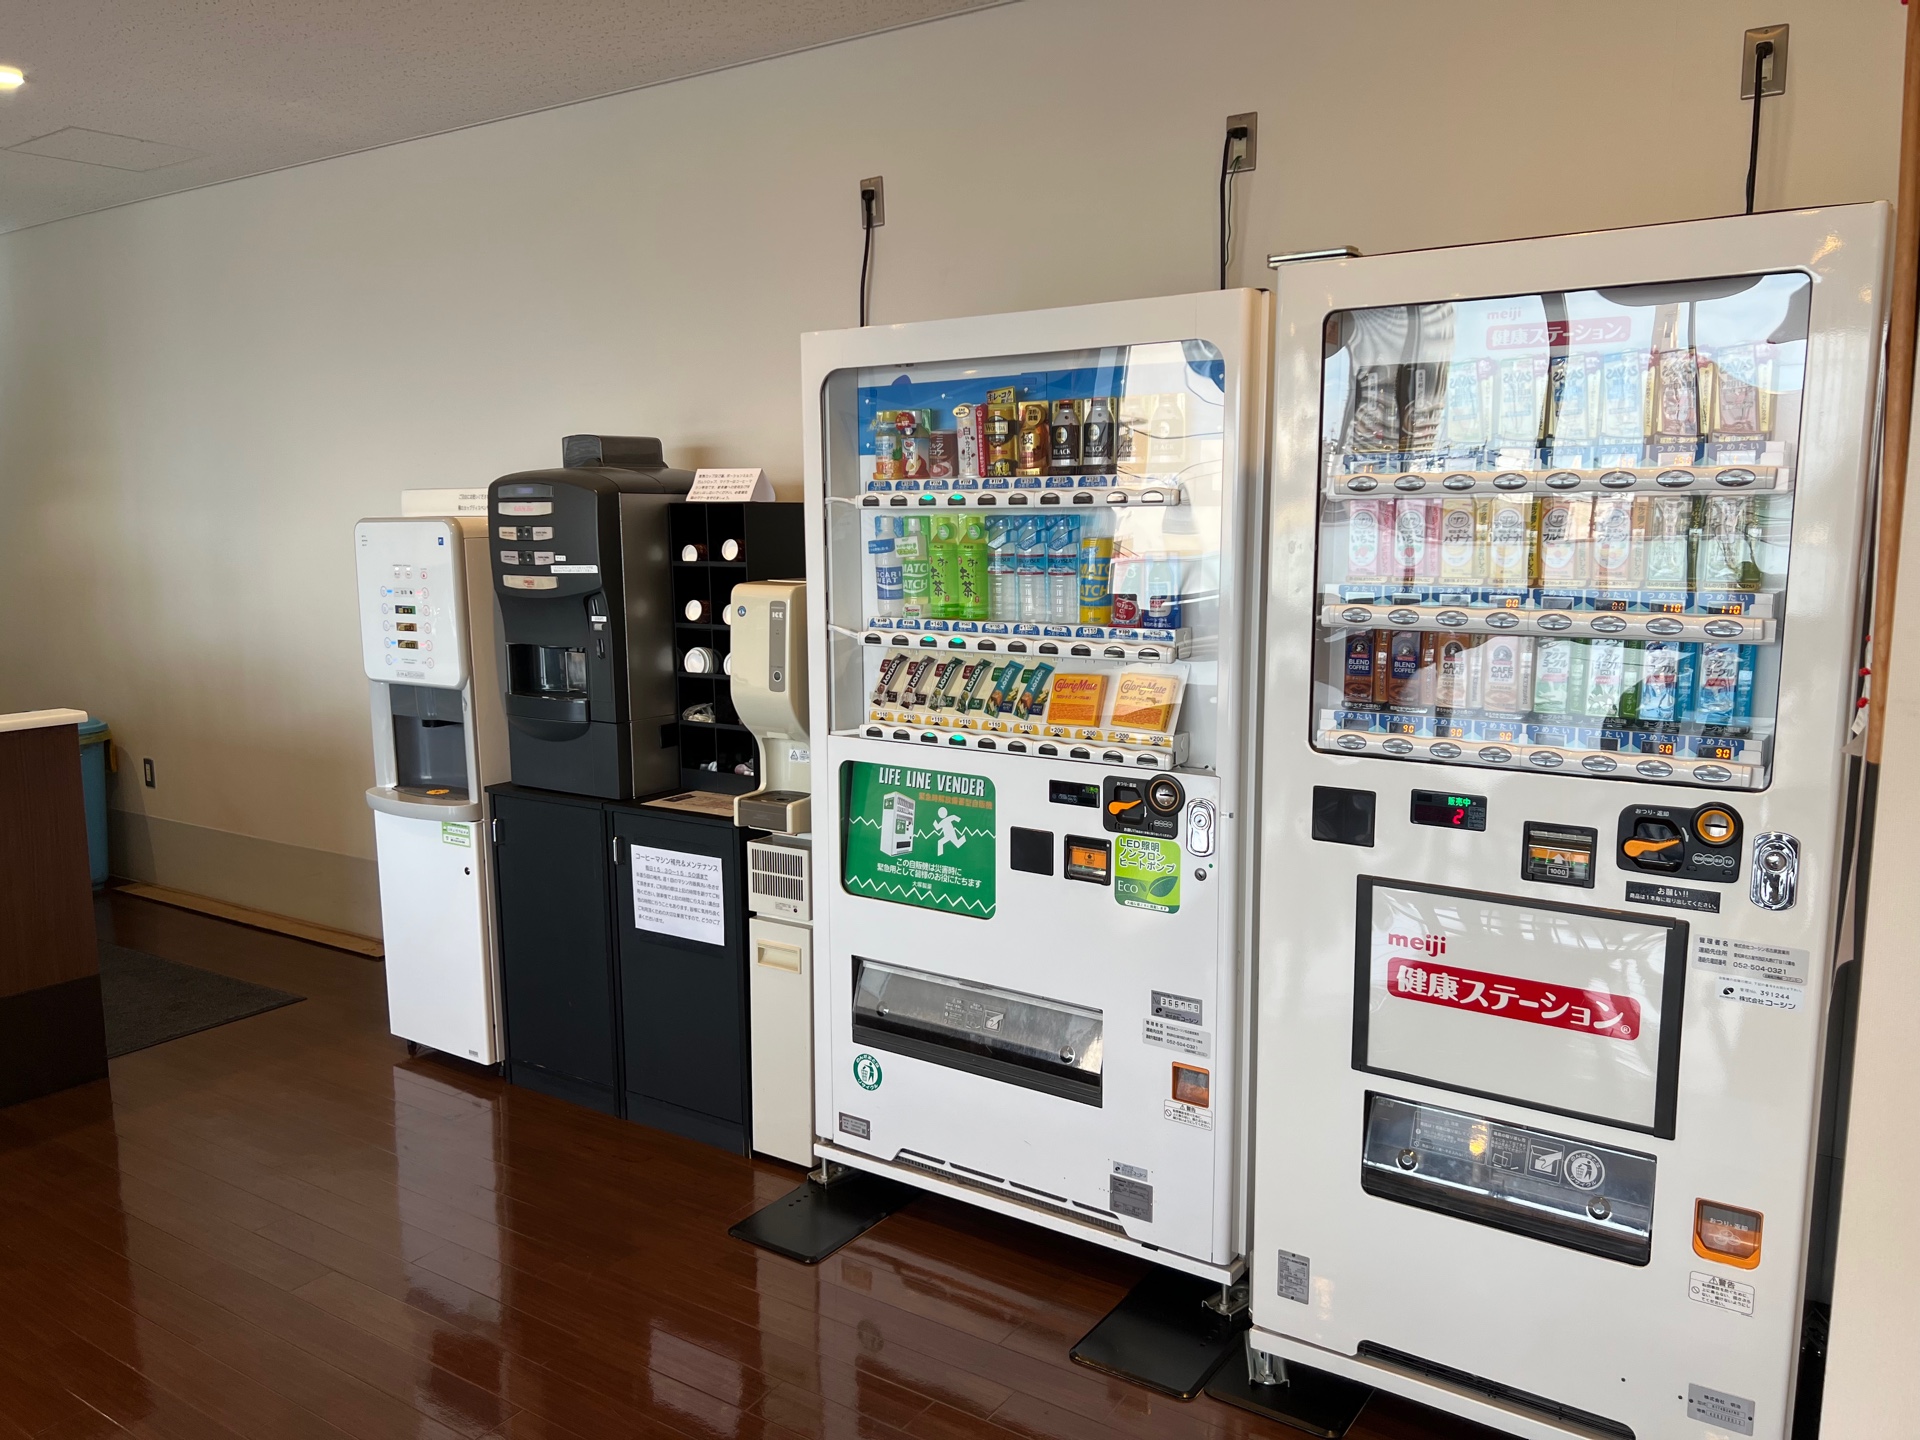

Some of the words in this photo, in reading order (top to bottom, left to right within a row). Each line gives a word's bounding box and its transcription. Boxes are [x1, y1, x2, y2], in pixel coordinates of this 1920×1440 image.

[1487, 308, 1522, 320] meiji
[1714, 442, 1760, 451] つめたい
[1444, 534, 1472, 542] バナナ
[1493, 534, 1522, 542] バナナ
[1390, 586, 1429, 594] つめたい
[1538, 589, 1577, 597] つめたい
[1586, 590, 1632, 599] つめたい
[1647, 591, 1689, 600] つめたい
[1705, 592, 1749, 601] つめたい
[1662, 603, 1682, 613] 110
[1721, 605, 1741, 615] 110
[1542, 659, 1568, 668] ヨーグル
[1491, 665, 1513, 674] CAFÉ
[1706, 668, 1735, 677] ヨーグル
[1054, 679, 1098, 692] CalorieMate
[1338, 712, 1372, 720] つめたい
[1385, 715, 1419, 723] つめたい
[1433, 719, 1468, 727] つめたい
[1480, 722, 1518, 730] つめたい
[1532, 725, 1570, 734] つめたい
[1585, 729, 1624, 738] つめたい
[1639, 733, 1680, 742] つめたい
[1696, 738, 1738, 747] つめたい
[879, 767, 901, 786] LIFE
[906, 770, 932, 790] LINE
[937, 774, 985, 797] VENDER
[1448, 796, 1471, 807] 販売中
[1452, 809, 1465, 825] 2
[1635, 808, 1670, 817] おつり・返却
[1119, 838, 1160, 853] LED照明
[1120, 848, 1165, 862] ノンフロン
[896, 858, 962, 876] この自販機は災害時に
[1120, 858, 1176, 873] ヒートポンプ
[877, 862, 982, 889] 緊急用として皆様のお役にたちます
[1550, 868, 1566, 876] 1000
[1657, 887, 1689, 898] お願い!!
[1388, 933, 1447, 957] meiji
[1698, 946, 1728, 957] 連絡先住所
[1733, 961, 1787, 975] 052-504-0321
[1396, 964, 1624, 1030] 健康ステーション
[1760, 990, 1790, 1000] 391244
[1739, 995, 1796, 1010] 株式会社コーシン
[1719, 1278, 1736, 1290] 警告
[1704, 1394, 1726, 1405] 株式会社
